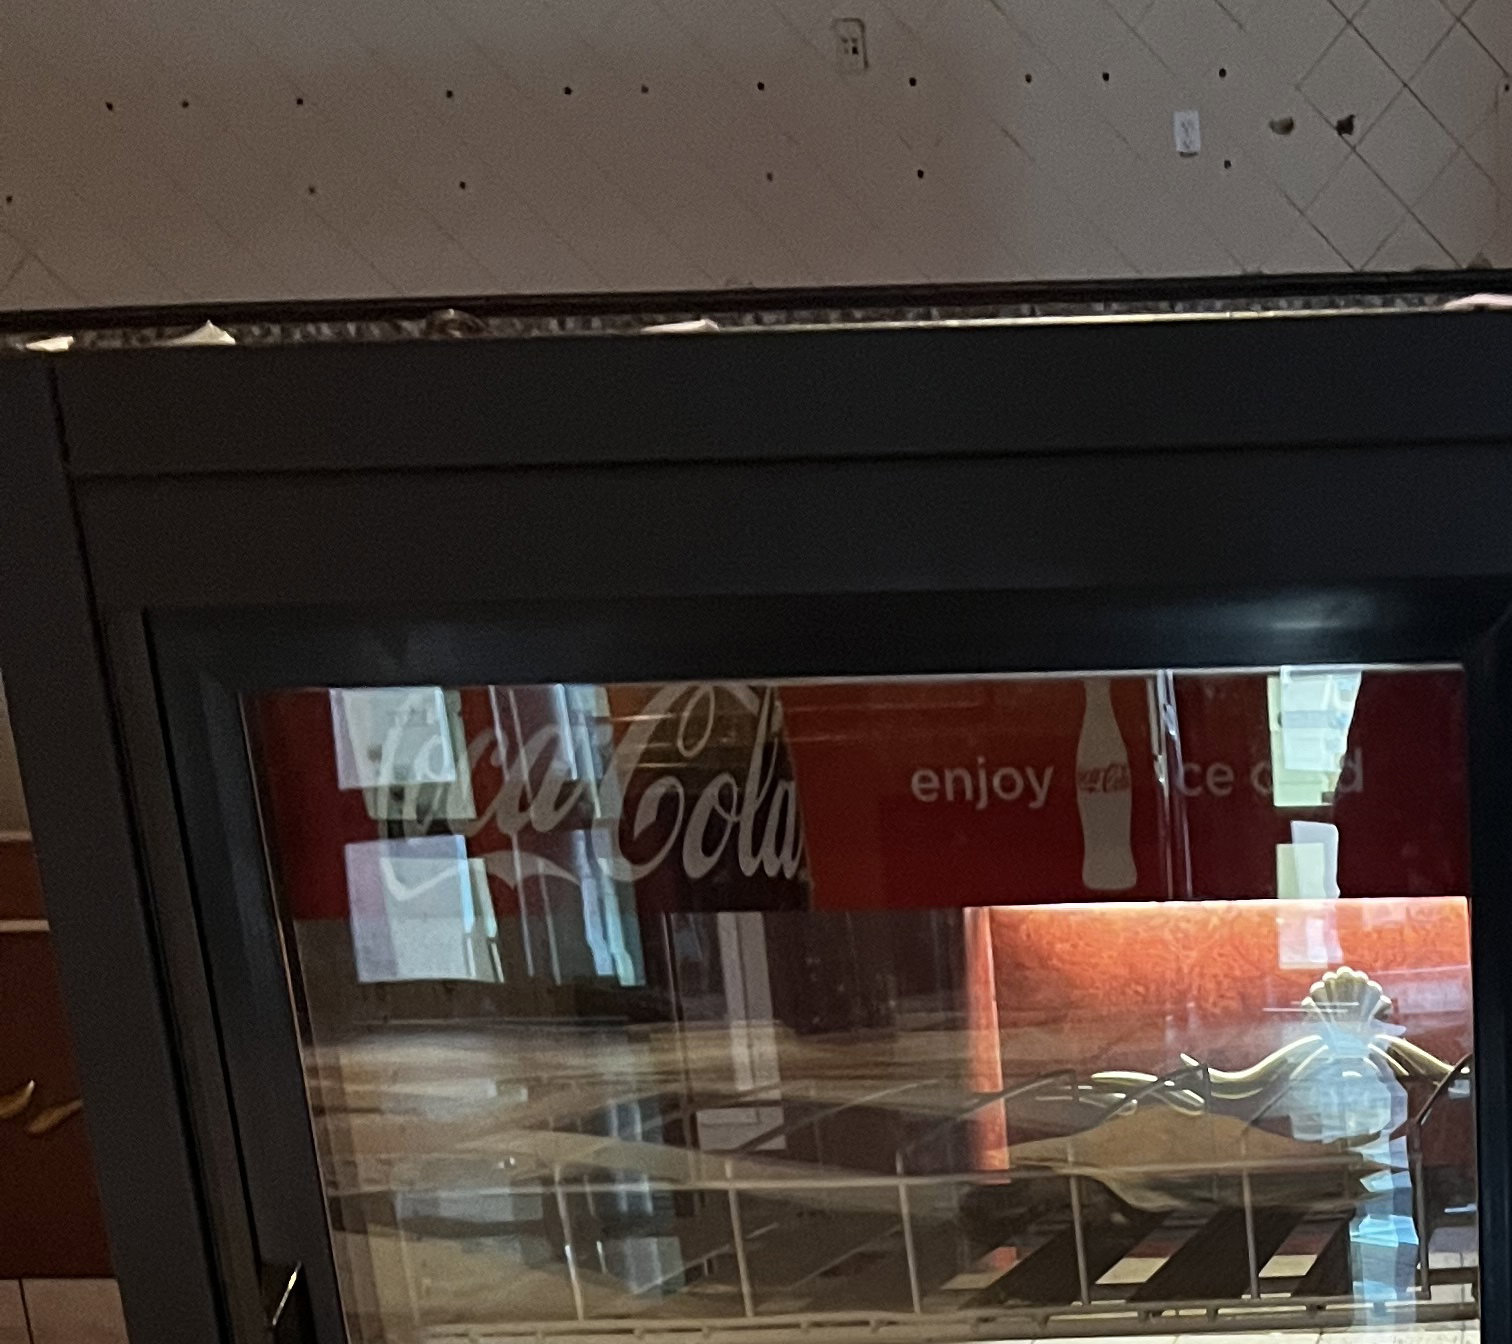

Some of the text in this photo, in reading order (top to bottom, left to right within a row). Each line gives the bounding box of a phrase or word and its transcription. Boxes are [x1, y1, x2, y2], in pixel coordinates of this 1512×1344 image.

[910, 756, 1055, 810] enjoy
[1170, 756, 1236, 798] ce
[1250, 746, 1364, 796] cd
